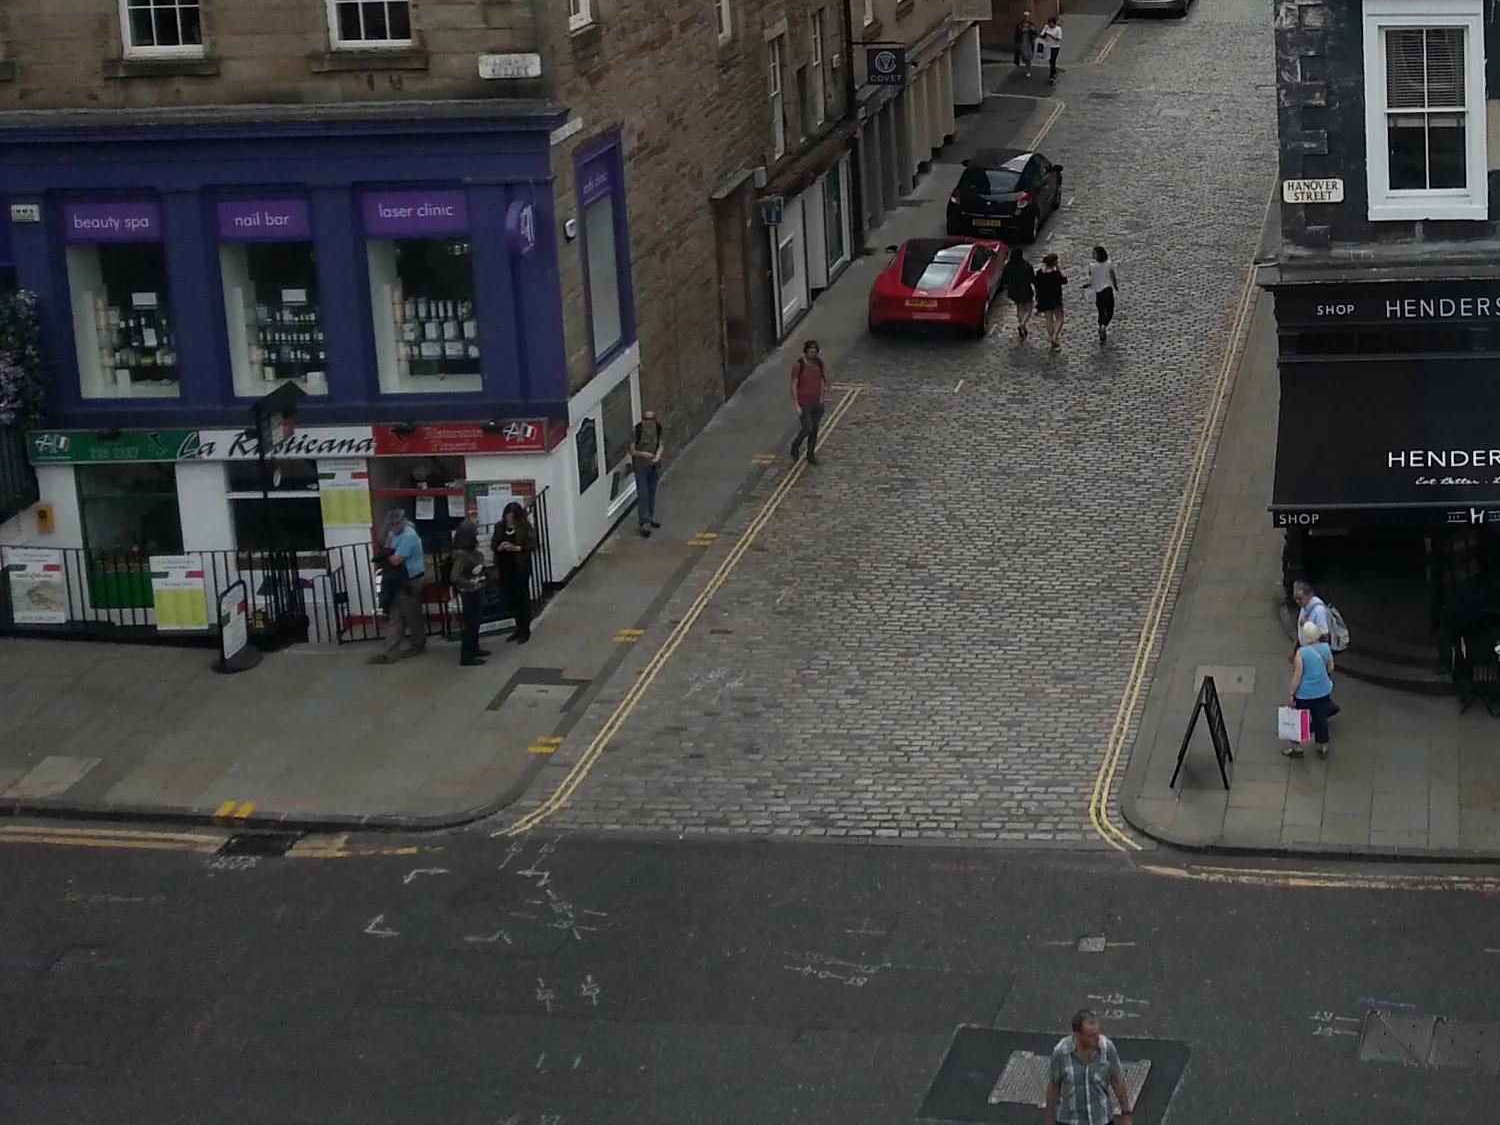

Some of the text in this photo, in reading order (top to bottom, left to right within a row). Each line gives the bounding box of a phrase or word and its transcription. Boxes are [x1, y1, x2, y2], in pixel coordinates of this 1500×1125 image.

[870, 75, 902, 83] COVET
[1287, 180, 1339, 192] HANOVER
[1294, 191, 1333, 202] STREET
[378, 203, 453, 218] laser clinic
[73, 215, 150, 231] beauty spa
[235, 211, 290, 226] nail bar
[1316, 303, 1355, 315] SHOP
[176, 431, 375, 459] La Rsticana
[1278, 513, 1320, 525] SHOP
